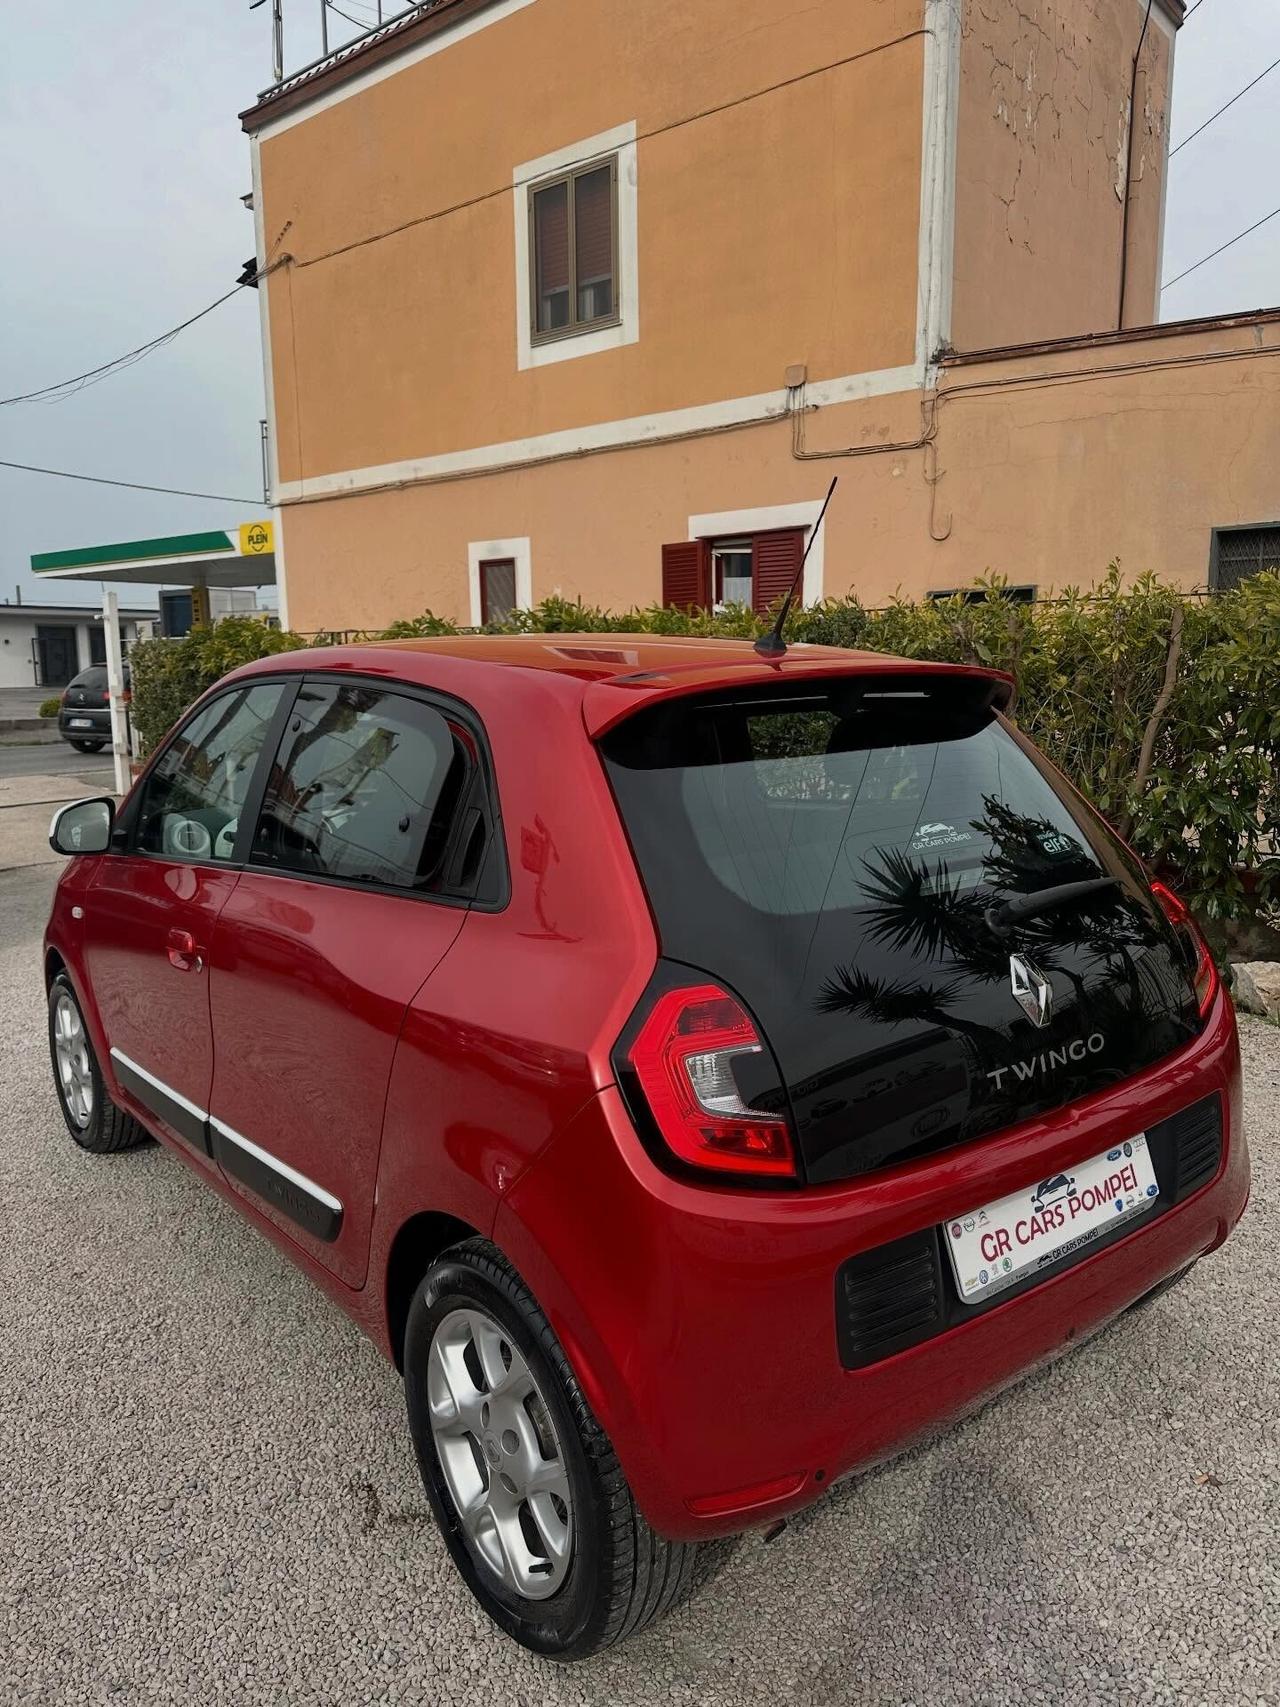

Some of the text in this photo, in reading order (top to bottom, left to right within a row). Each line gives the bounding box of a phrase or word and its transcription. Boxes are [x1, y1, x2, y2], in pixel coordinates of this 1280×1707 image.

[248, 532, 268, 545] PLEIN
[986, 1033, 1105, 1089] TWINGO
[981, 1228, 1012, 1262] GR
[1015, 1204, 1065, 1245] CARS
[1068, 1163, 1138, 1219] POMPEI
[1052, 1227, 1099, 1260] GR CARS POMPEI
